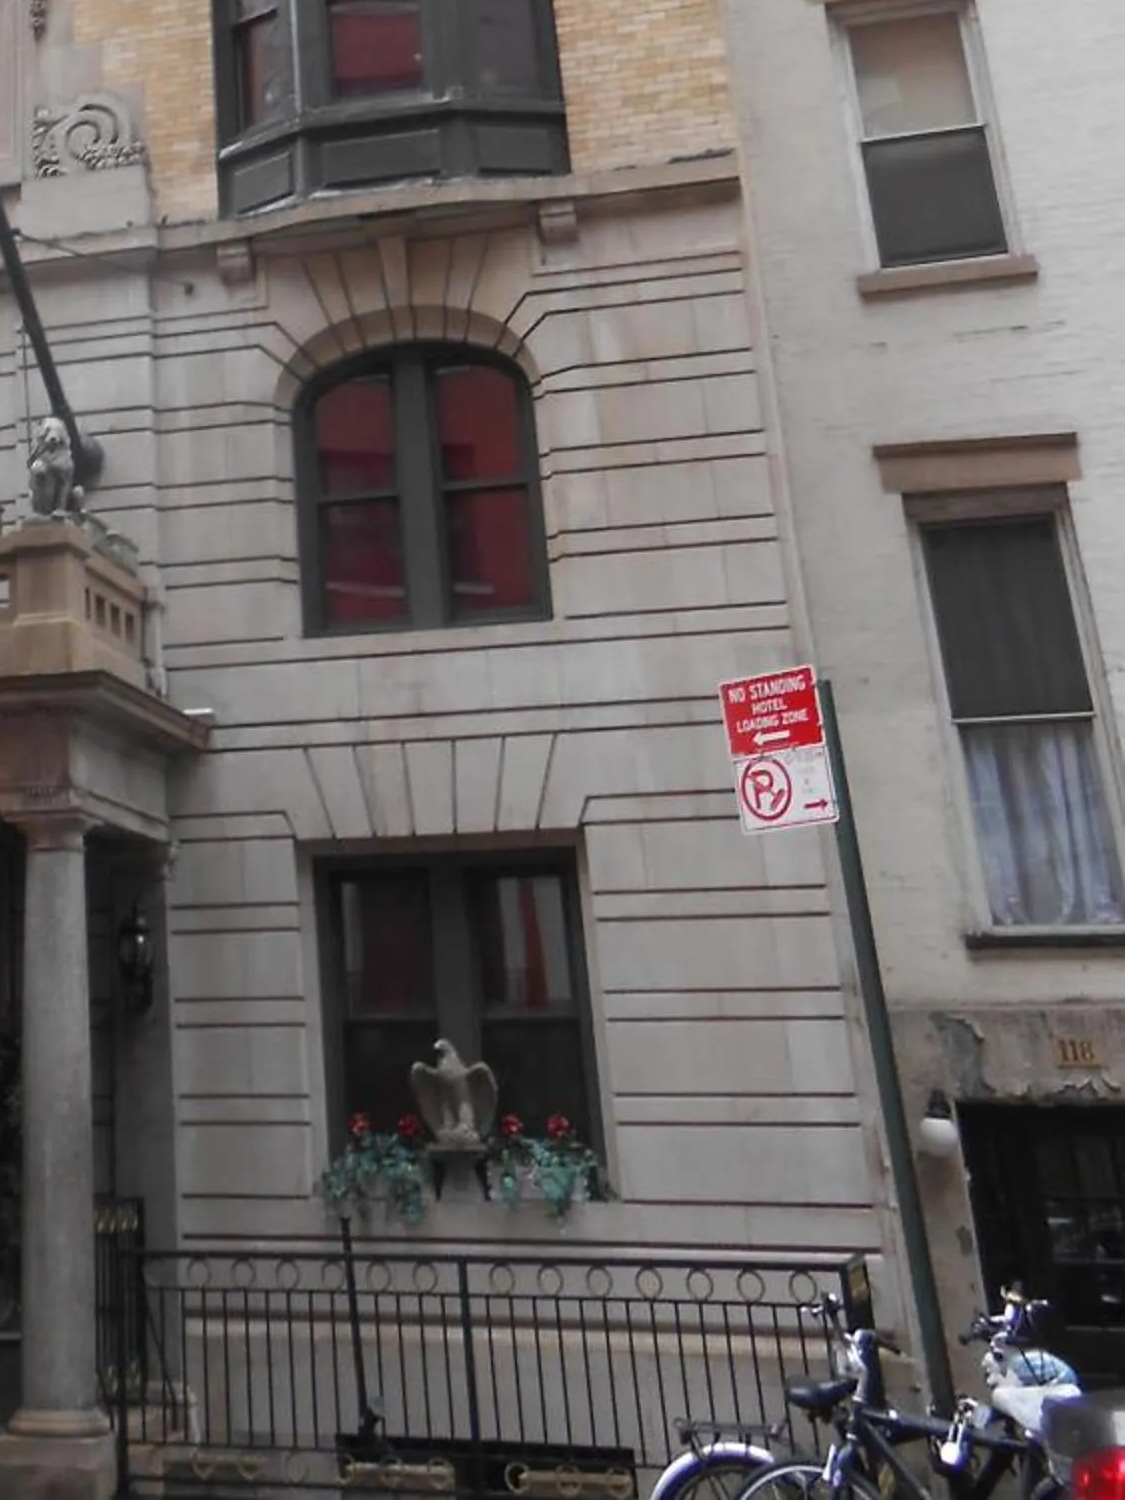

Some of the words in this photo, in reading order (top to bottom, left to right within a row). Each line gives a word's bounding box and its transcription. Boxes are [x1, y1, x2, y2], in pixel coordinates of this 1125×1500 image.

[728, 688, 746, 704] NO
[749, 675, 806, 701] STANDING
[751, 698, 788, 716] HOTEL
[736, 714, 780, 734] LOADING
[782, 708, 810, 725] ZONE
[1058, 1038, 1095, 1062] 118
